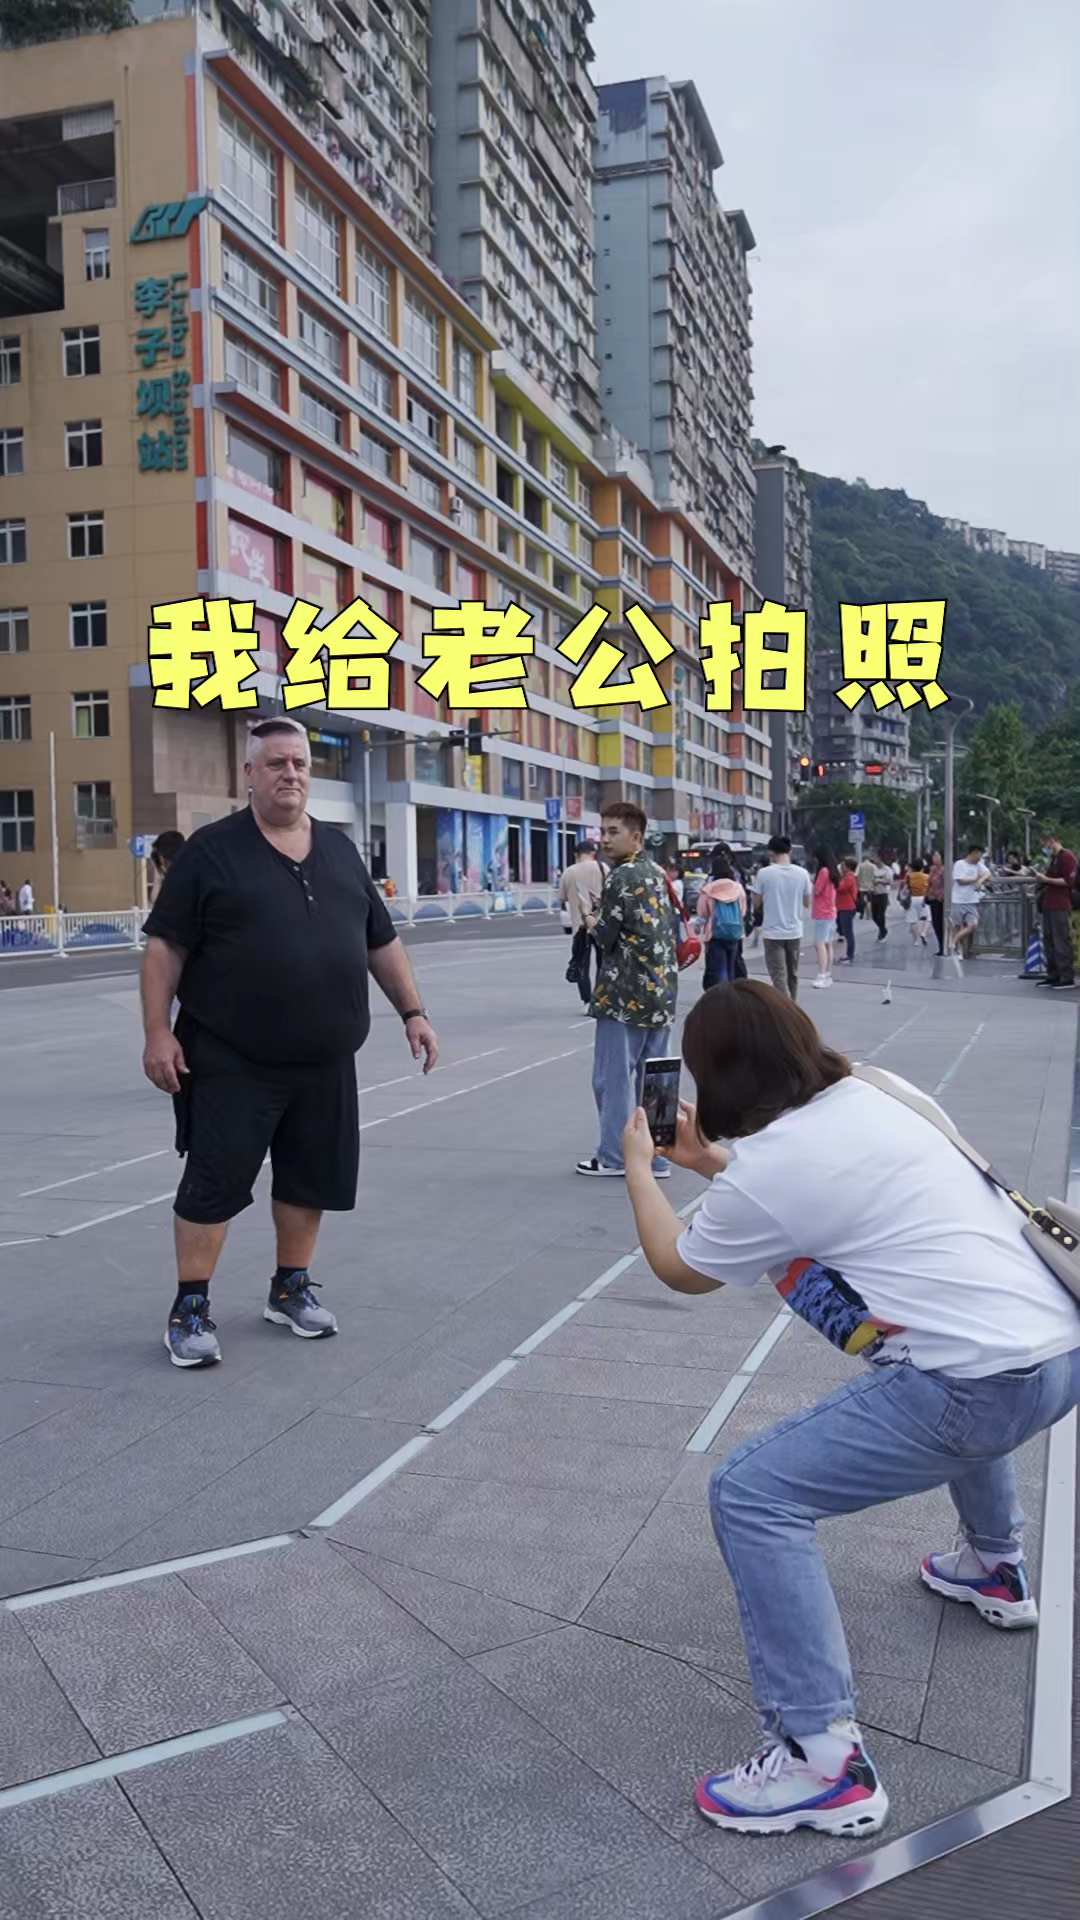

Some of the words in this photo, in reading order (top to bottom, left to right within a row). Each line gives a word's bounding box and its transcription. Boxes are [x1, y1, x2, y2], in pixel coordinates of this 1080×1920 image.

[135, 276, 171, 472] 李子坝站
[172, 369, 191, 472] Station
[850, 814, 861, 828] P
